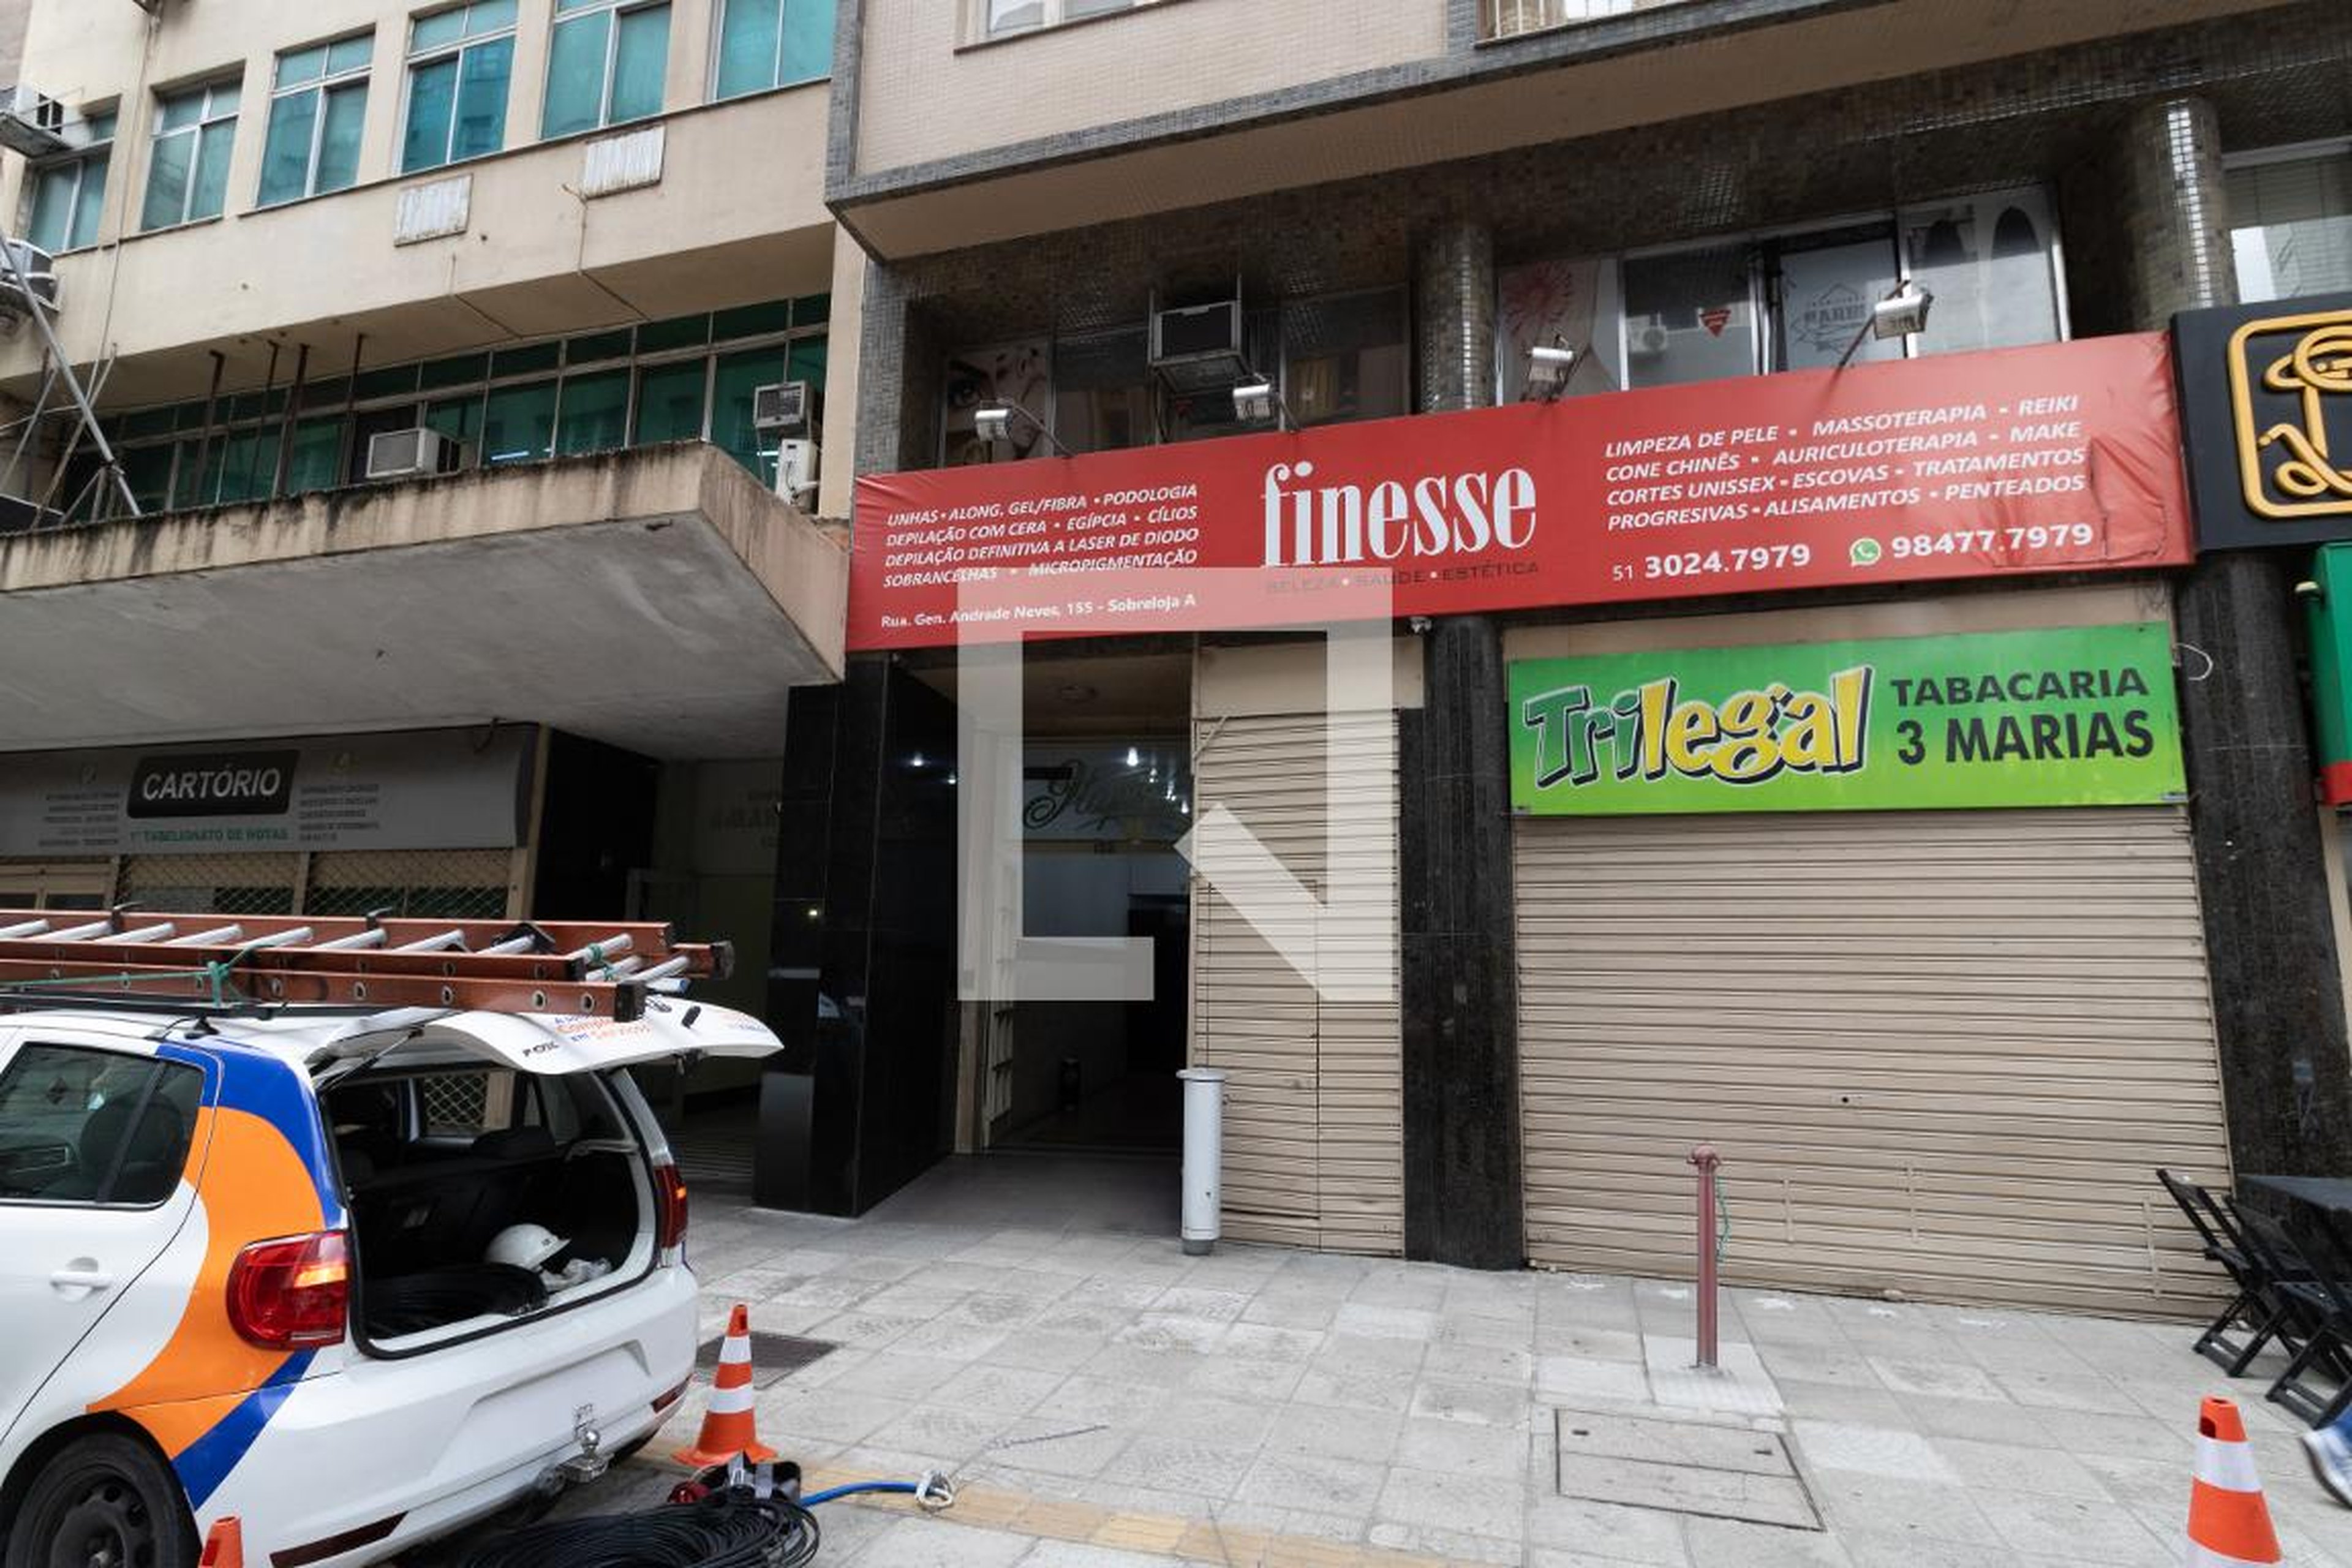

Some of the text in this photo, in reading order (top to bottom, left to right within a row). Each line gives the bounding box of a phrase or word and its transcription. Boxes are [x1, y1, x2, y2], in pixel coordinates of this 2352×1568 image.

[1605, 395, 2078, 458] LIMPEZA DE PELE MASSOTERAPIA REIKI
[1606, 421, 2081, 482] CONE CHINÊS AURICULOTERAPIA MAKE
[888, 484, 1197, 526] UNHAS ALONG. GEL/FIBRA PODOLOGIA
[1607, 448, 2087, 506] CORTES UNISSEX ESCOVAS TRATAMENTOS
[1608, 475, 2086, 531] PROGRESIVAS ALISAMENTOS PENTEADOS
[886, 506, 1197, 546] DEPILAÇÃO COM CERA EGÍPCIA CÍLIOS
[1261, 461, 1536, 568] finesse
[883, 548, 1197, 587] SOBRANCELHAS MICROPIGMENTAÇÃO
[884, 527, 1199, 567] DEPILAÇÃO DEFINITIVA A LASER DE DIODO
[1612, 524, 2093, 581] 51 3024.7979 98477.7979
[1184, 593, 1196, 606] A
[1890, 667, 2150, 707] TABACARIA
[1523, 665, 1874, 788] Trilegal
[1896, 709, 2154, 766] 3 MARIAS
[144, 764, 281, 800] CARTÓRIO
